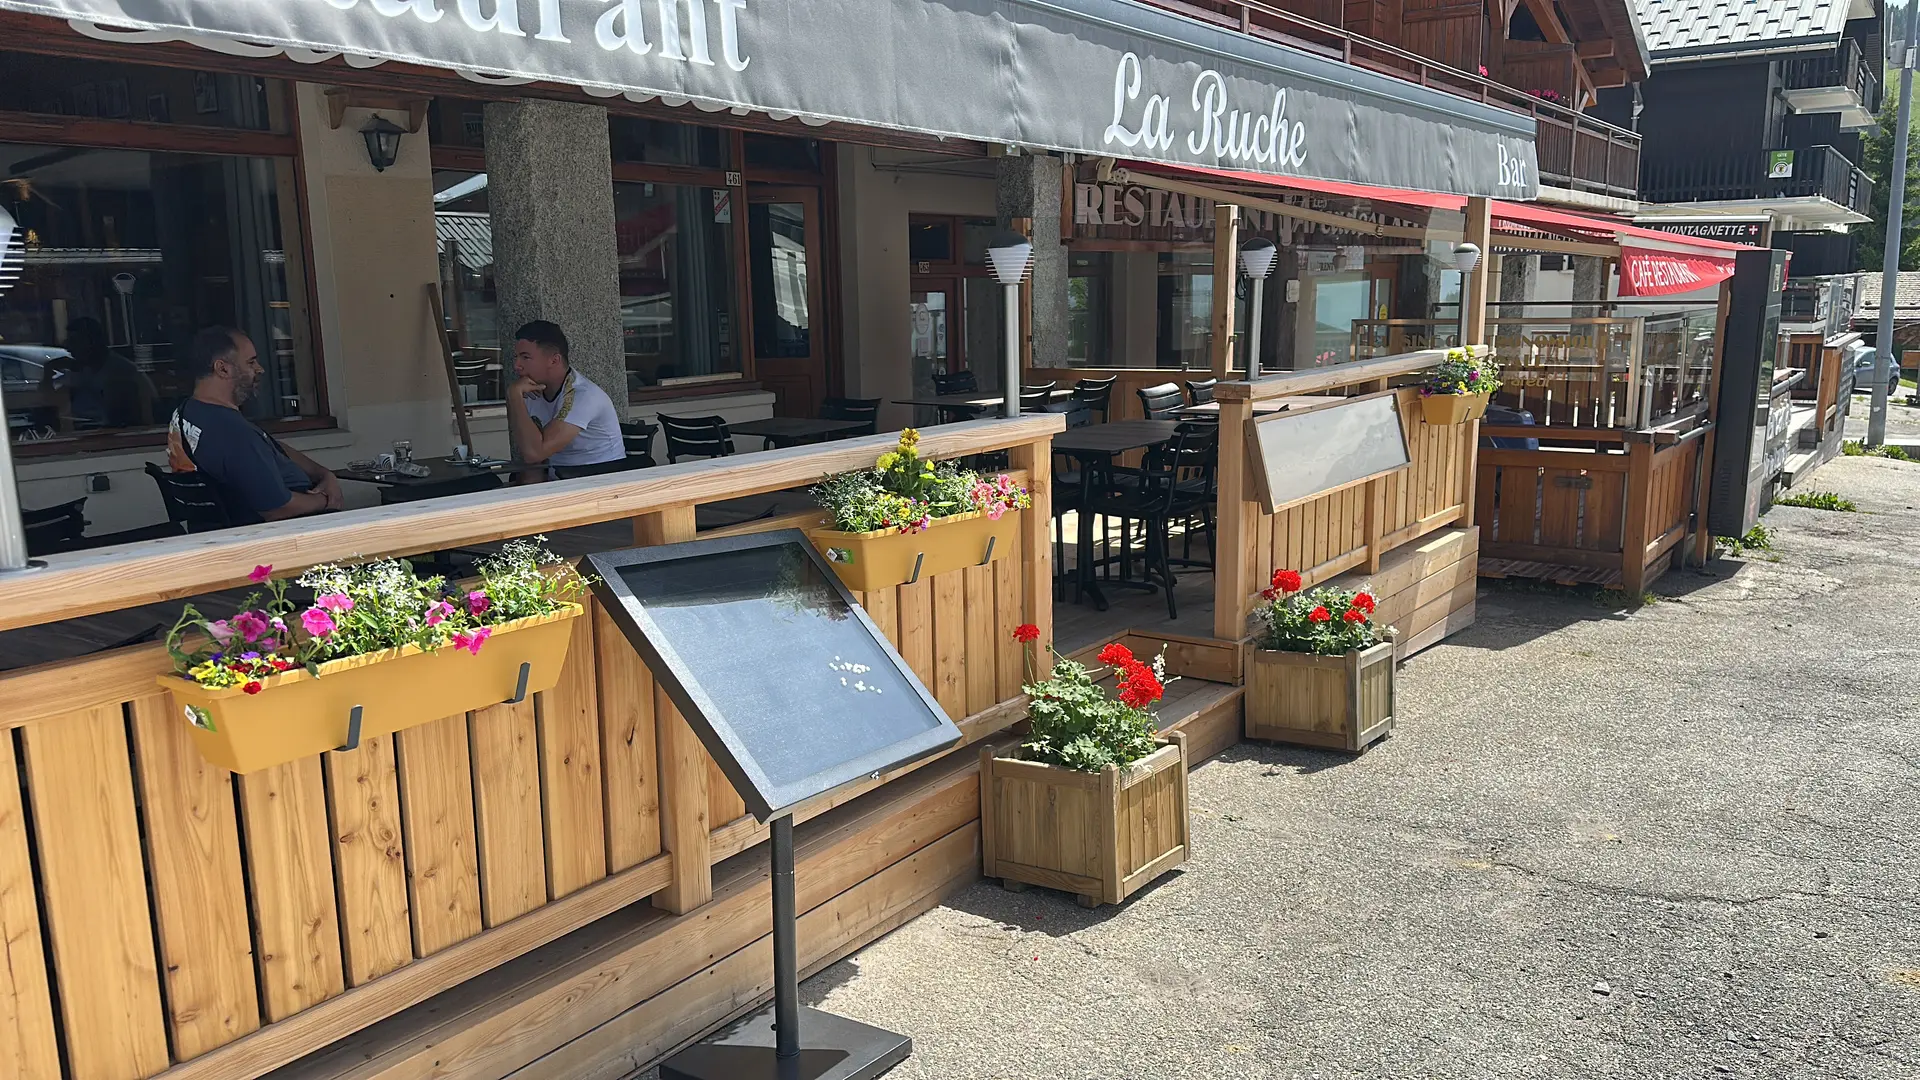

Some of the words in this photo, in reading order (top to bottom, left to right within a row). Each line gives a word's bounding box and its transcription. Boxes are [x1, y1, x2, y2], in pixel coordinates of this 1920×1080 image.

[1104, 52, 1175, 151] La
[1187, 70, 1308, 168] Ruche
[728, 173, 741, 185] 461
[1497, 143, 1528, 188] Bar
[1631, 254, 1654, 288] CAFÉ
